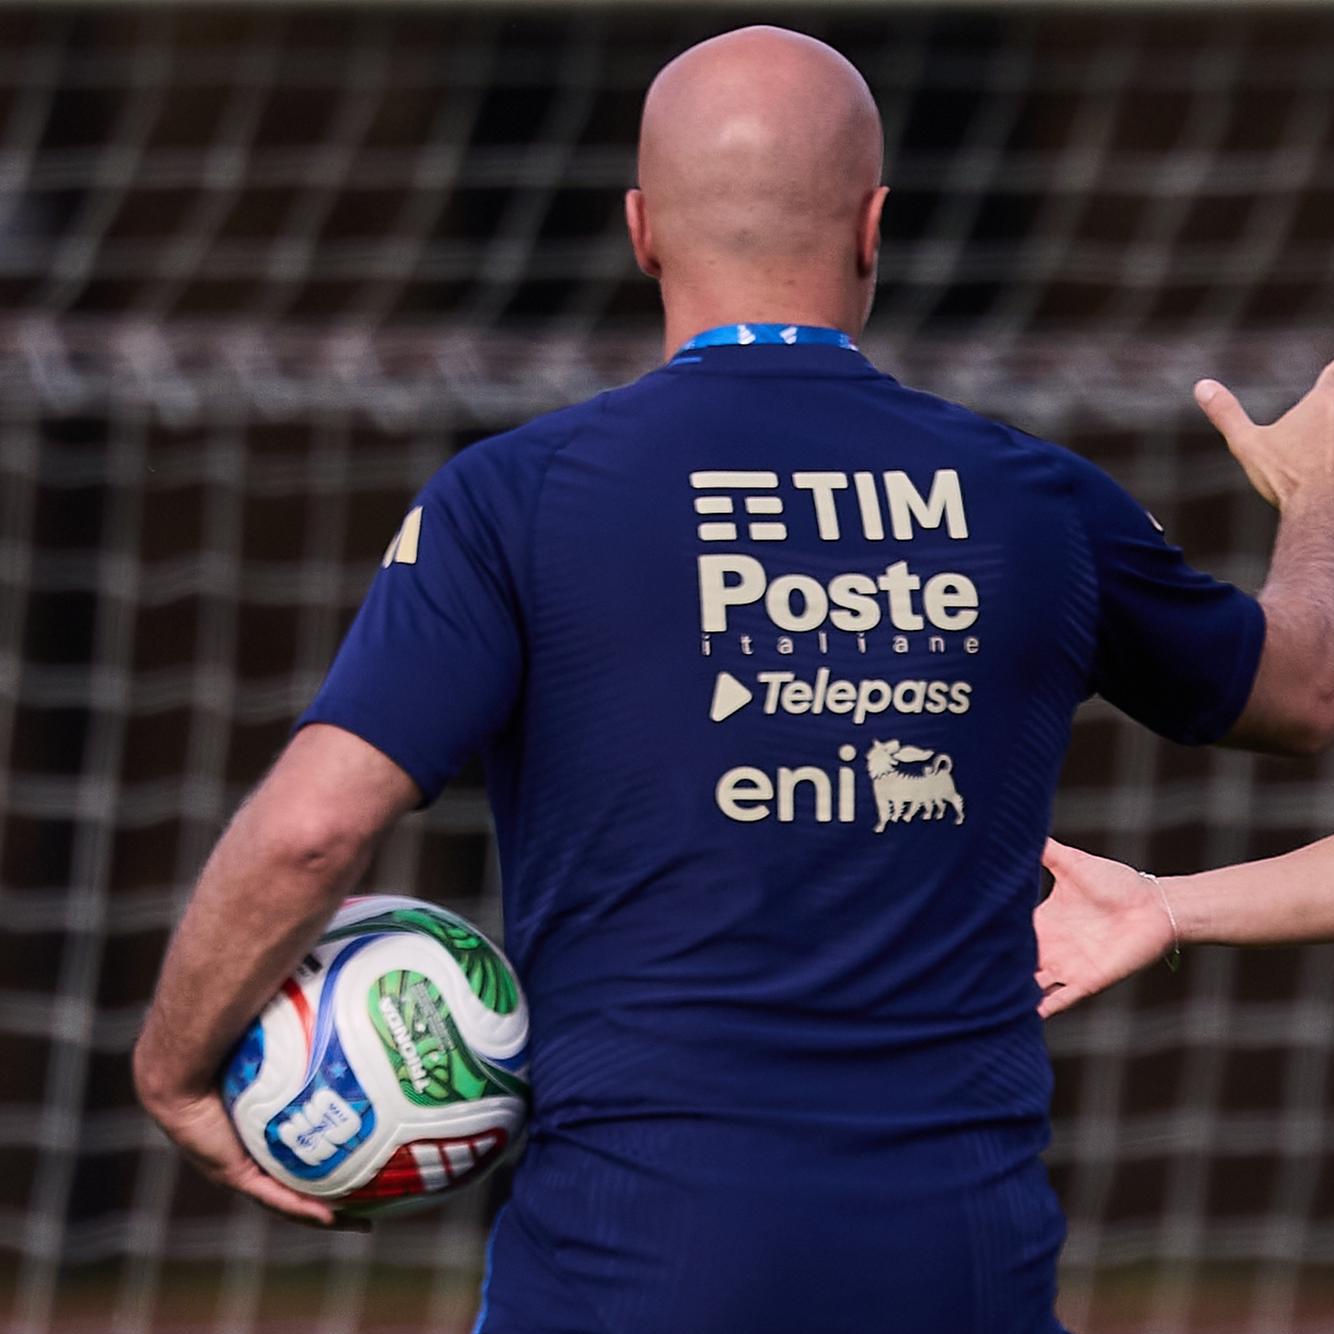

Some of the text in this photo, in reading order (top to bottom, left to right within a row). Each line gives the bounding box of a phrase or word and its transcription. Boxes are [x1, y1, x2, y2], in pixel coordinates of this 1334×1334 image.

[792, 469, 969, 540] TIM
[698, 553, 980, 632] Poste
[702, 631, 980, 656] italiane
[756, 667, 973, 725] Telepass
[715, 744, 857, 822] eni
